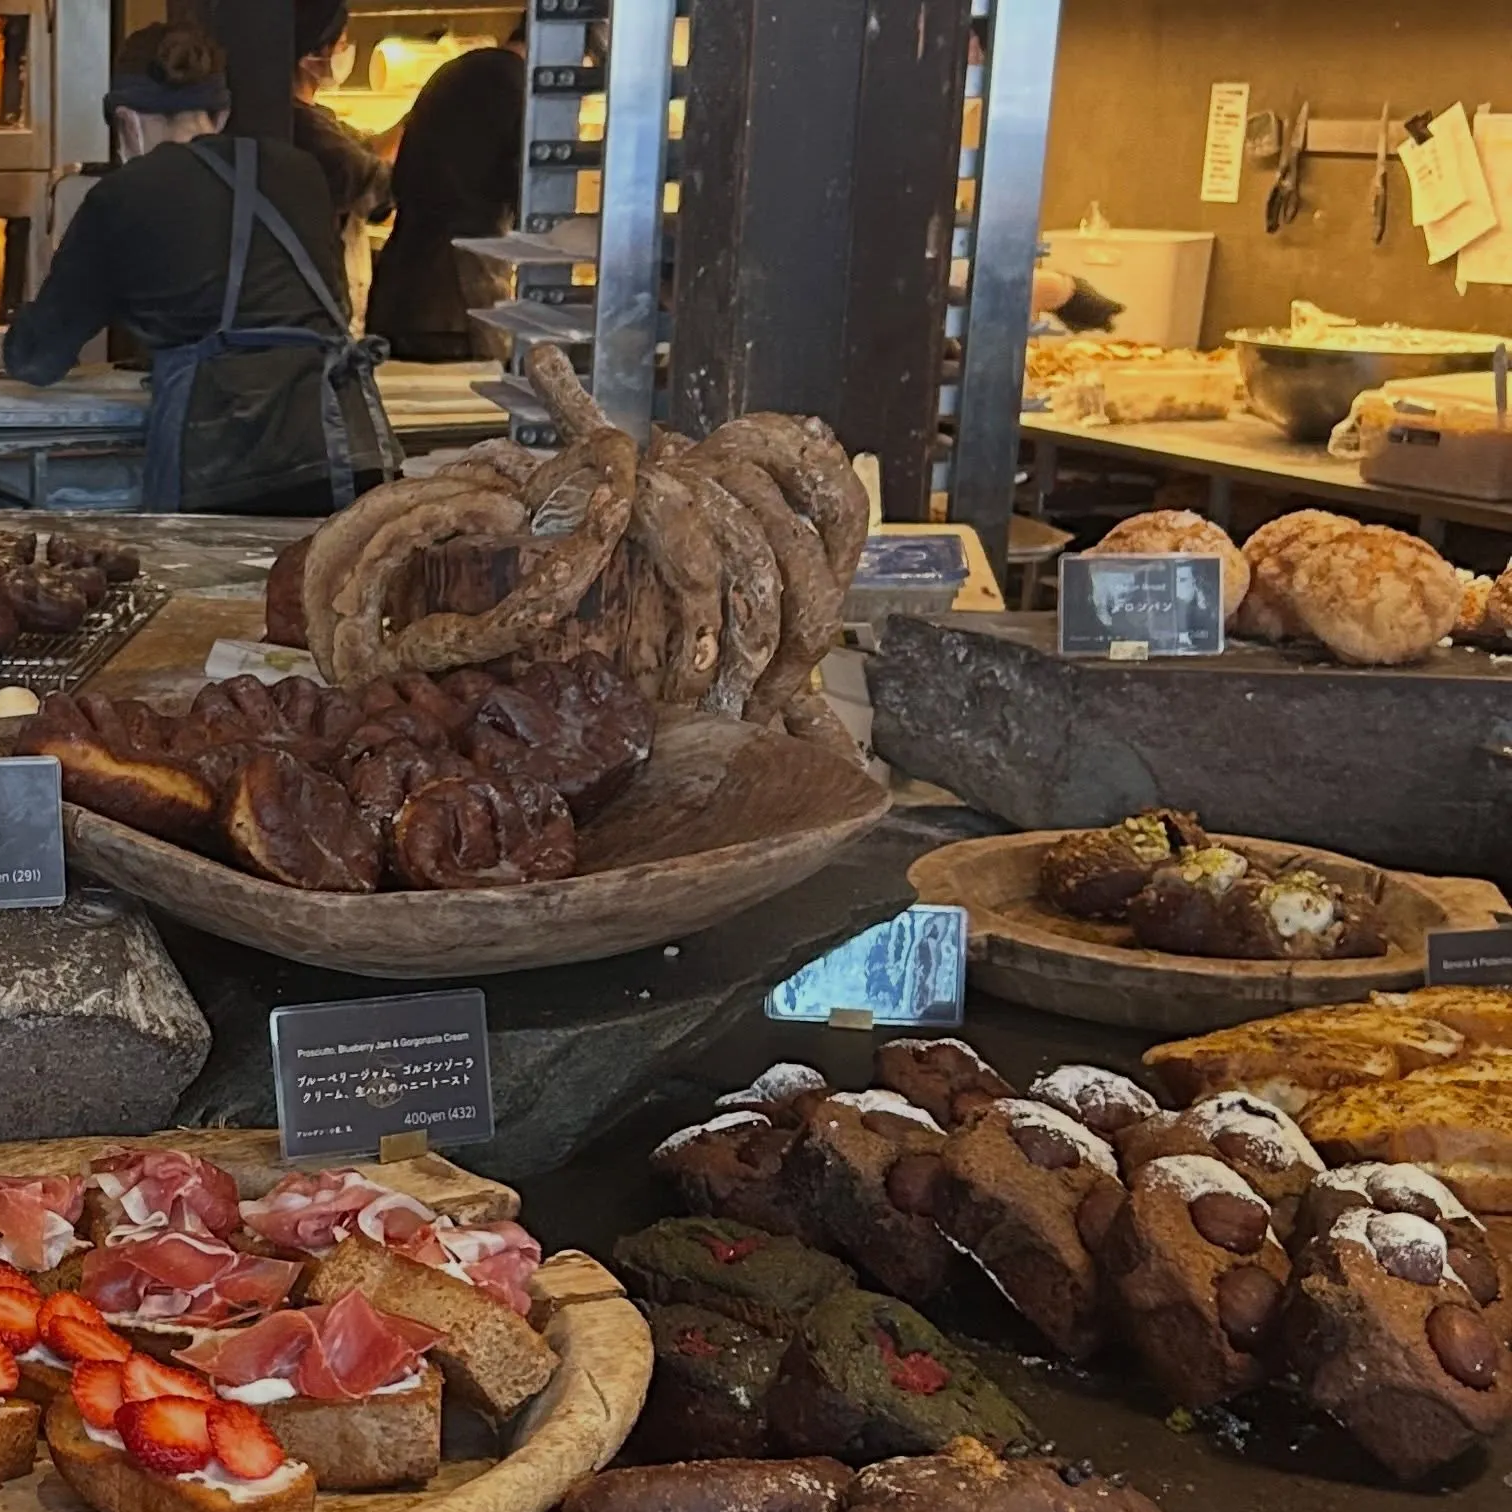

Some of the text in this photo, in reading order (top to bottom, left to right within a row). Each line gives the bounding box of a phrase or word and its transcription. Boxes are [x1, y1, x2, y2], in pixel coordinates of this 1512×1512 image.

[12, 869, 41, 883] (291)
[404, 1105, 476, 1125] 400yen (432)
